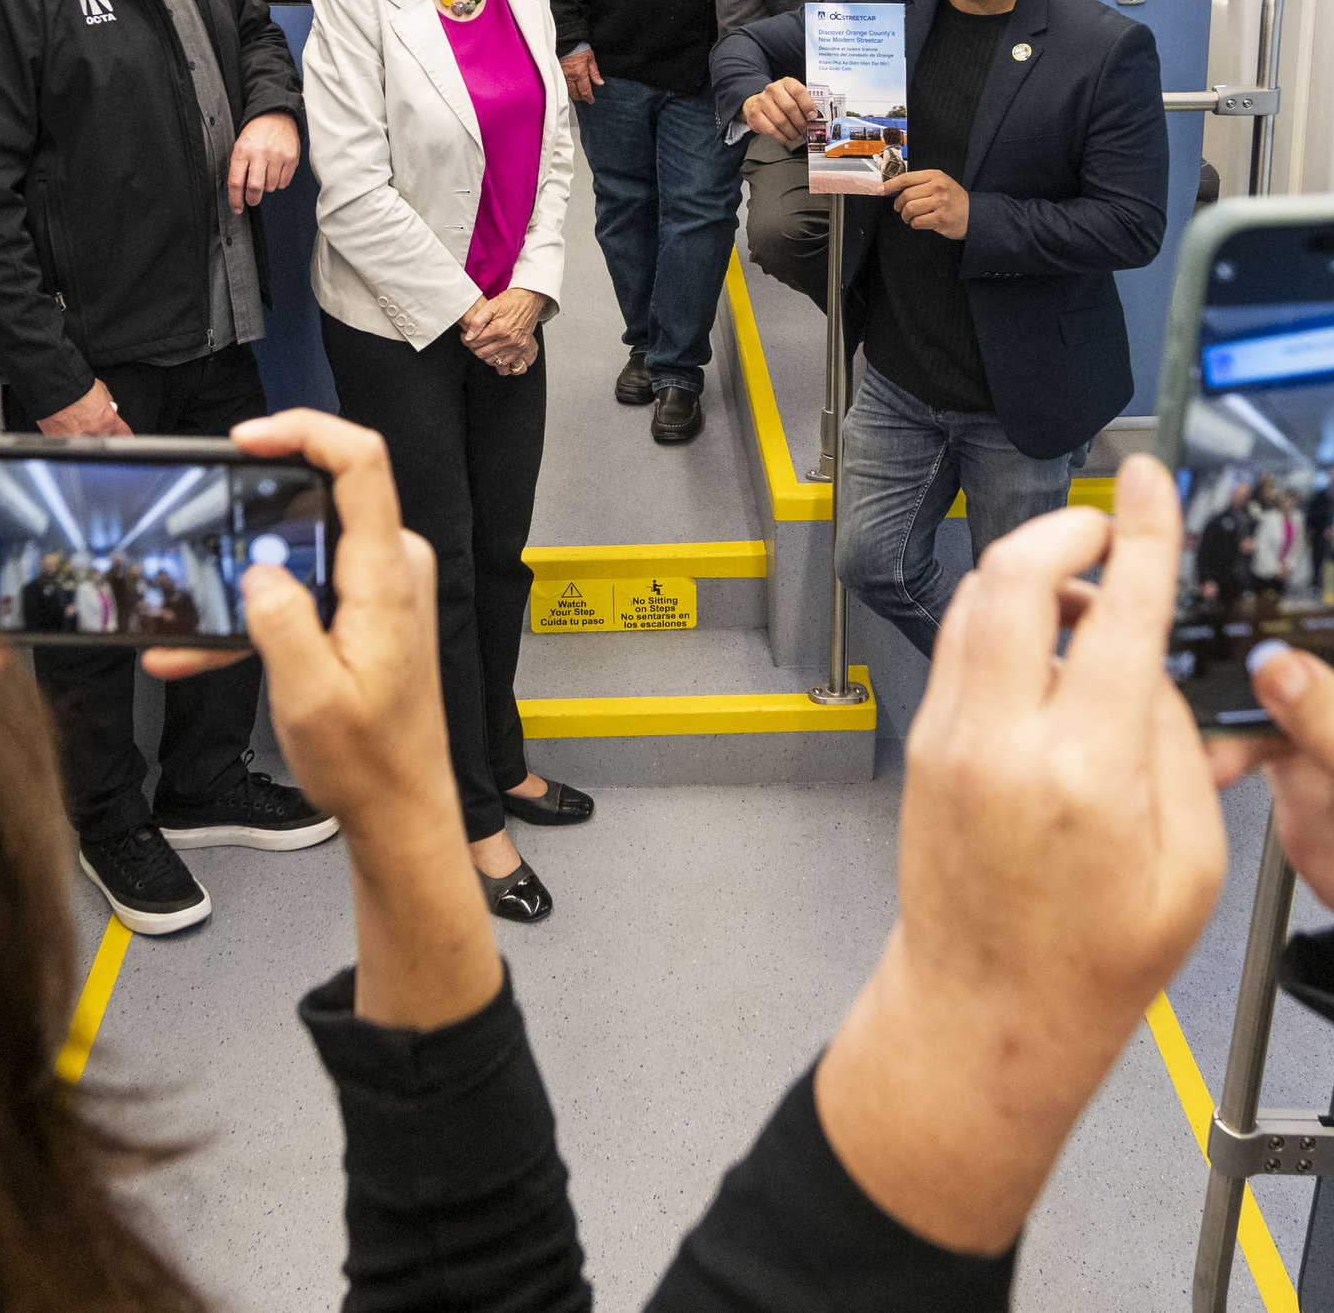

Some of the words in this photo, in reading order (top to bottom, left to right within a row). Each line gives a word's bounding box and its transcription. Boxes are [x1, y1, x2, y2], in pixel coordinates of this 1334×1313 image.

[86, 13, 117, 25] OCTA
[648, 597, 678, 605] Sitting
[574, 608, 595, 617] Step
[650, 605, 676, 613] Steps
[540, 618, 567, 626] Cuida
